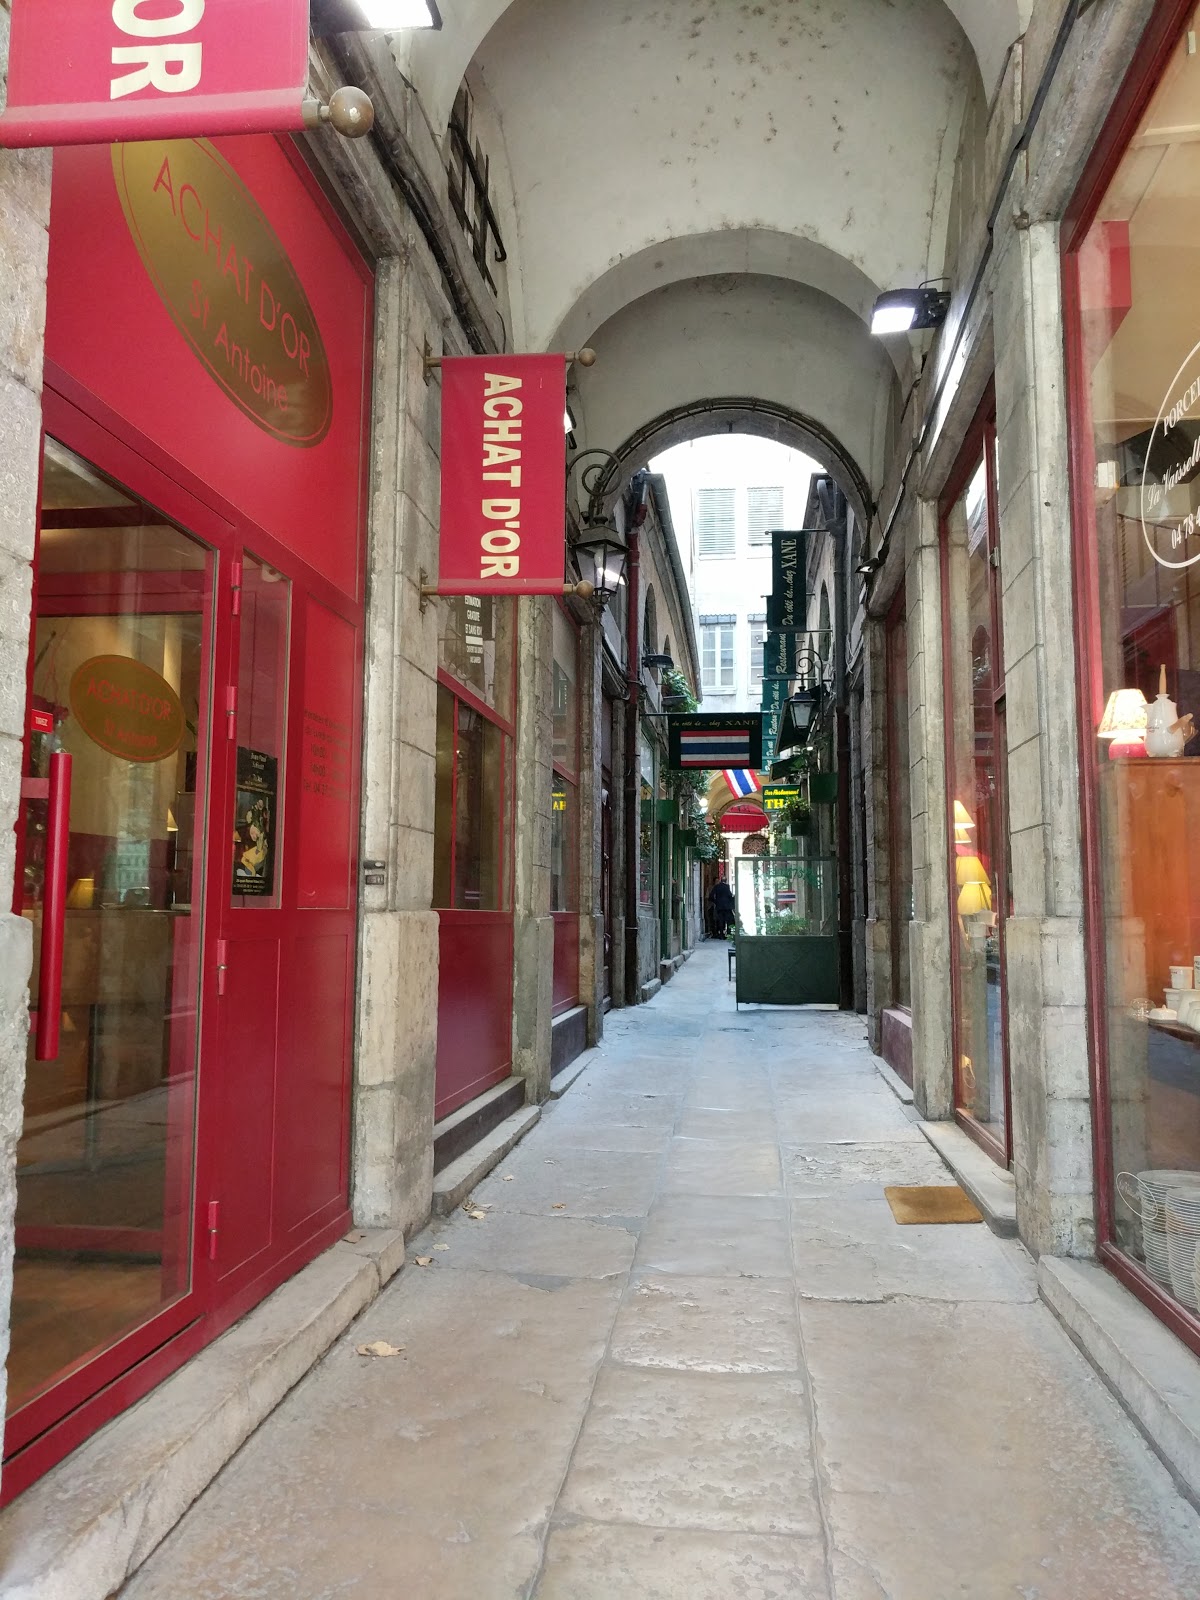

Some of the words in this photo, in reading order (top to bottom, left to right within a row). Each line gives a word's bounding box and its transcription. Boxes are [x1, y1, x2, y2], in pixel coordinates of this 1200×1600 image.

[153, 155, 254, 305] ACHAT
[259, 280, 311, 379] D'OR
[214, 322, 290, 413] Antoine
[482, 372, 523, 487] ACHAT
[1146, 482, 1163, 513] La
[479, 498, 522, 579] D'OR
[781, 538, 797, 568] XANE
[1171, 523, 1182, 550] 04
[1183, 513, 1194, 540] 78
[781, 614, 795, 626] Du
[86, 676, 137, 710] ACHAT
[138, 692, 172, 721] D'OR
